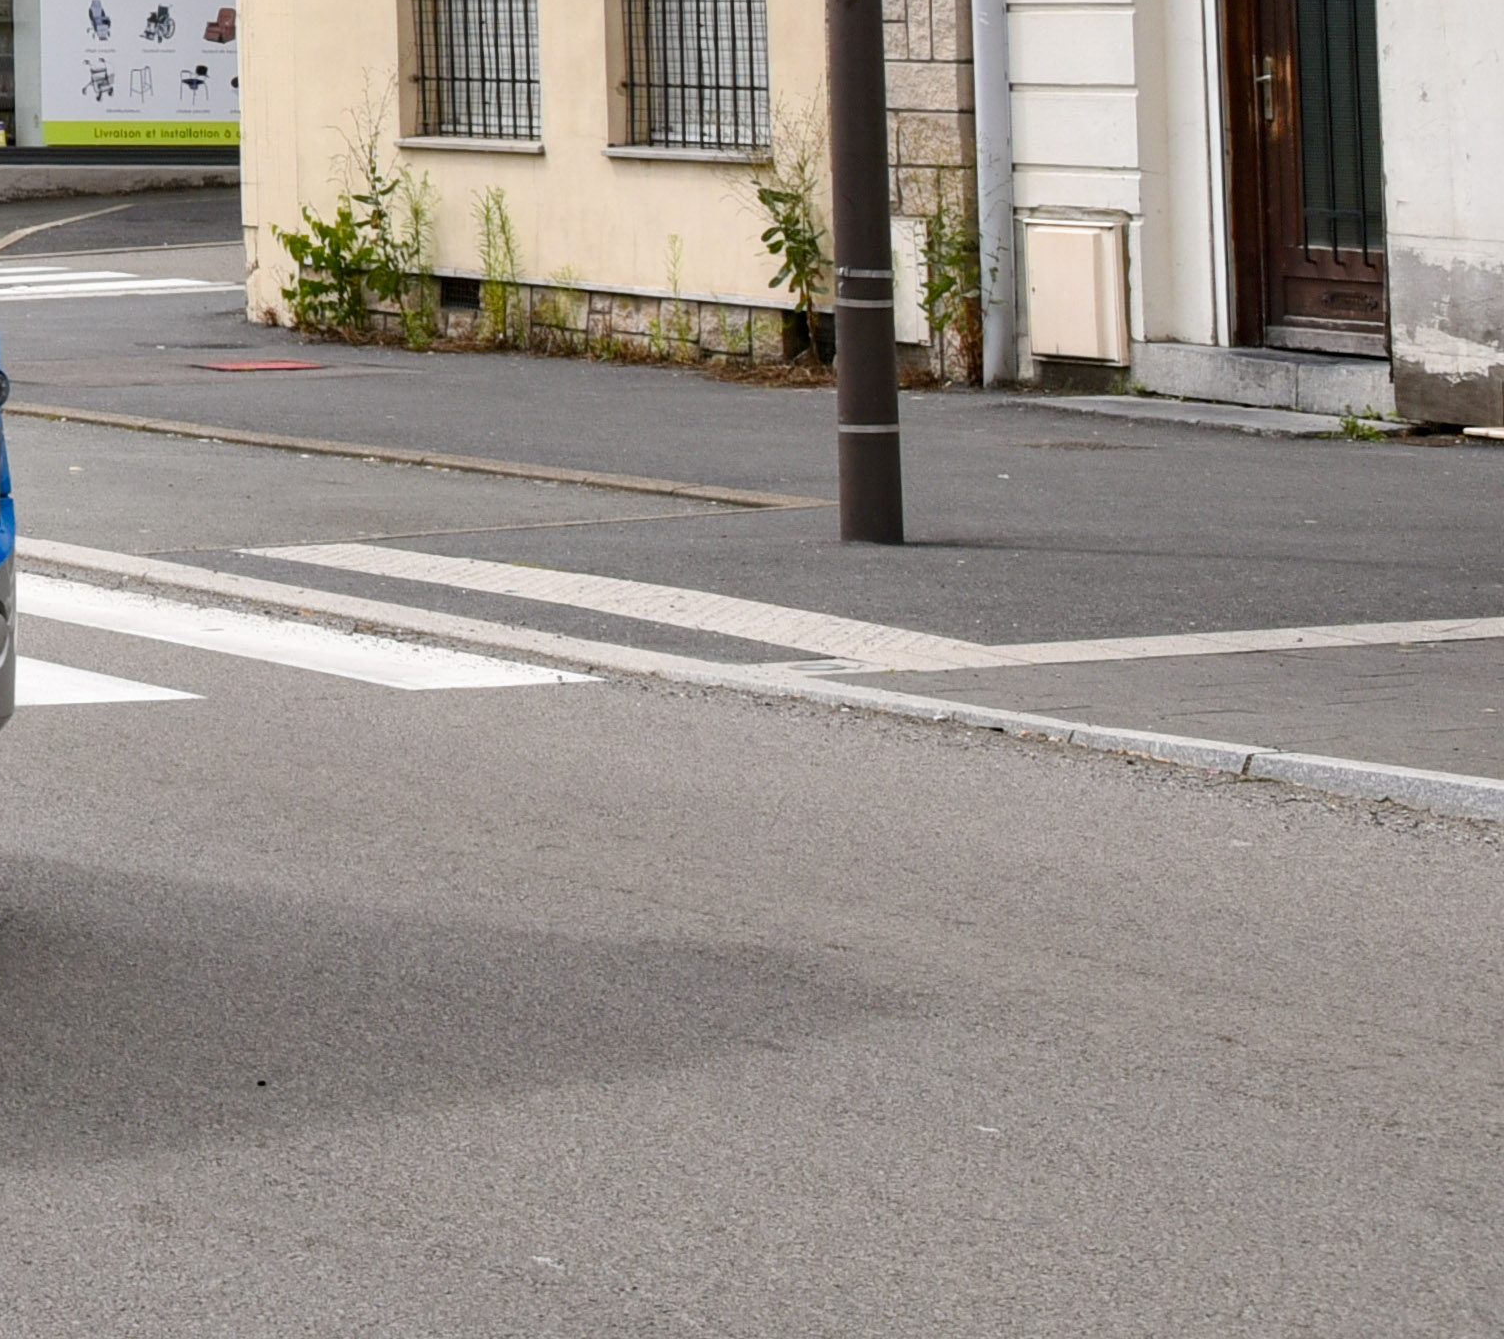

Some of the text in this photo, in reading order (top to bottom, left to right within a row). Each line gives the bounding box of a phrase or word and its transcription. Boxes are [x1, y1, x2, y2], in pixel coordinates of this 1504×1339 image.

[94, 127, 141, 139] Livraison
[146, 128, 156, 139] et
[161, 126, 220, 139] installation
[224, 126, 232, 139] à
